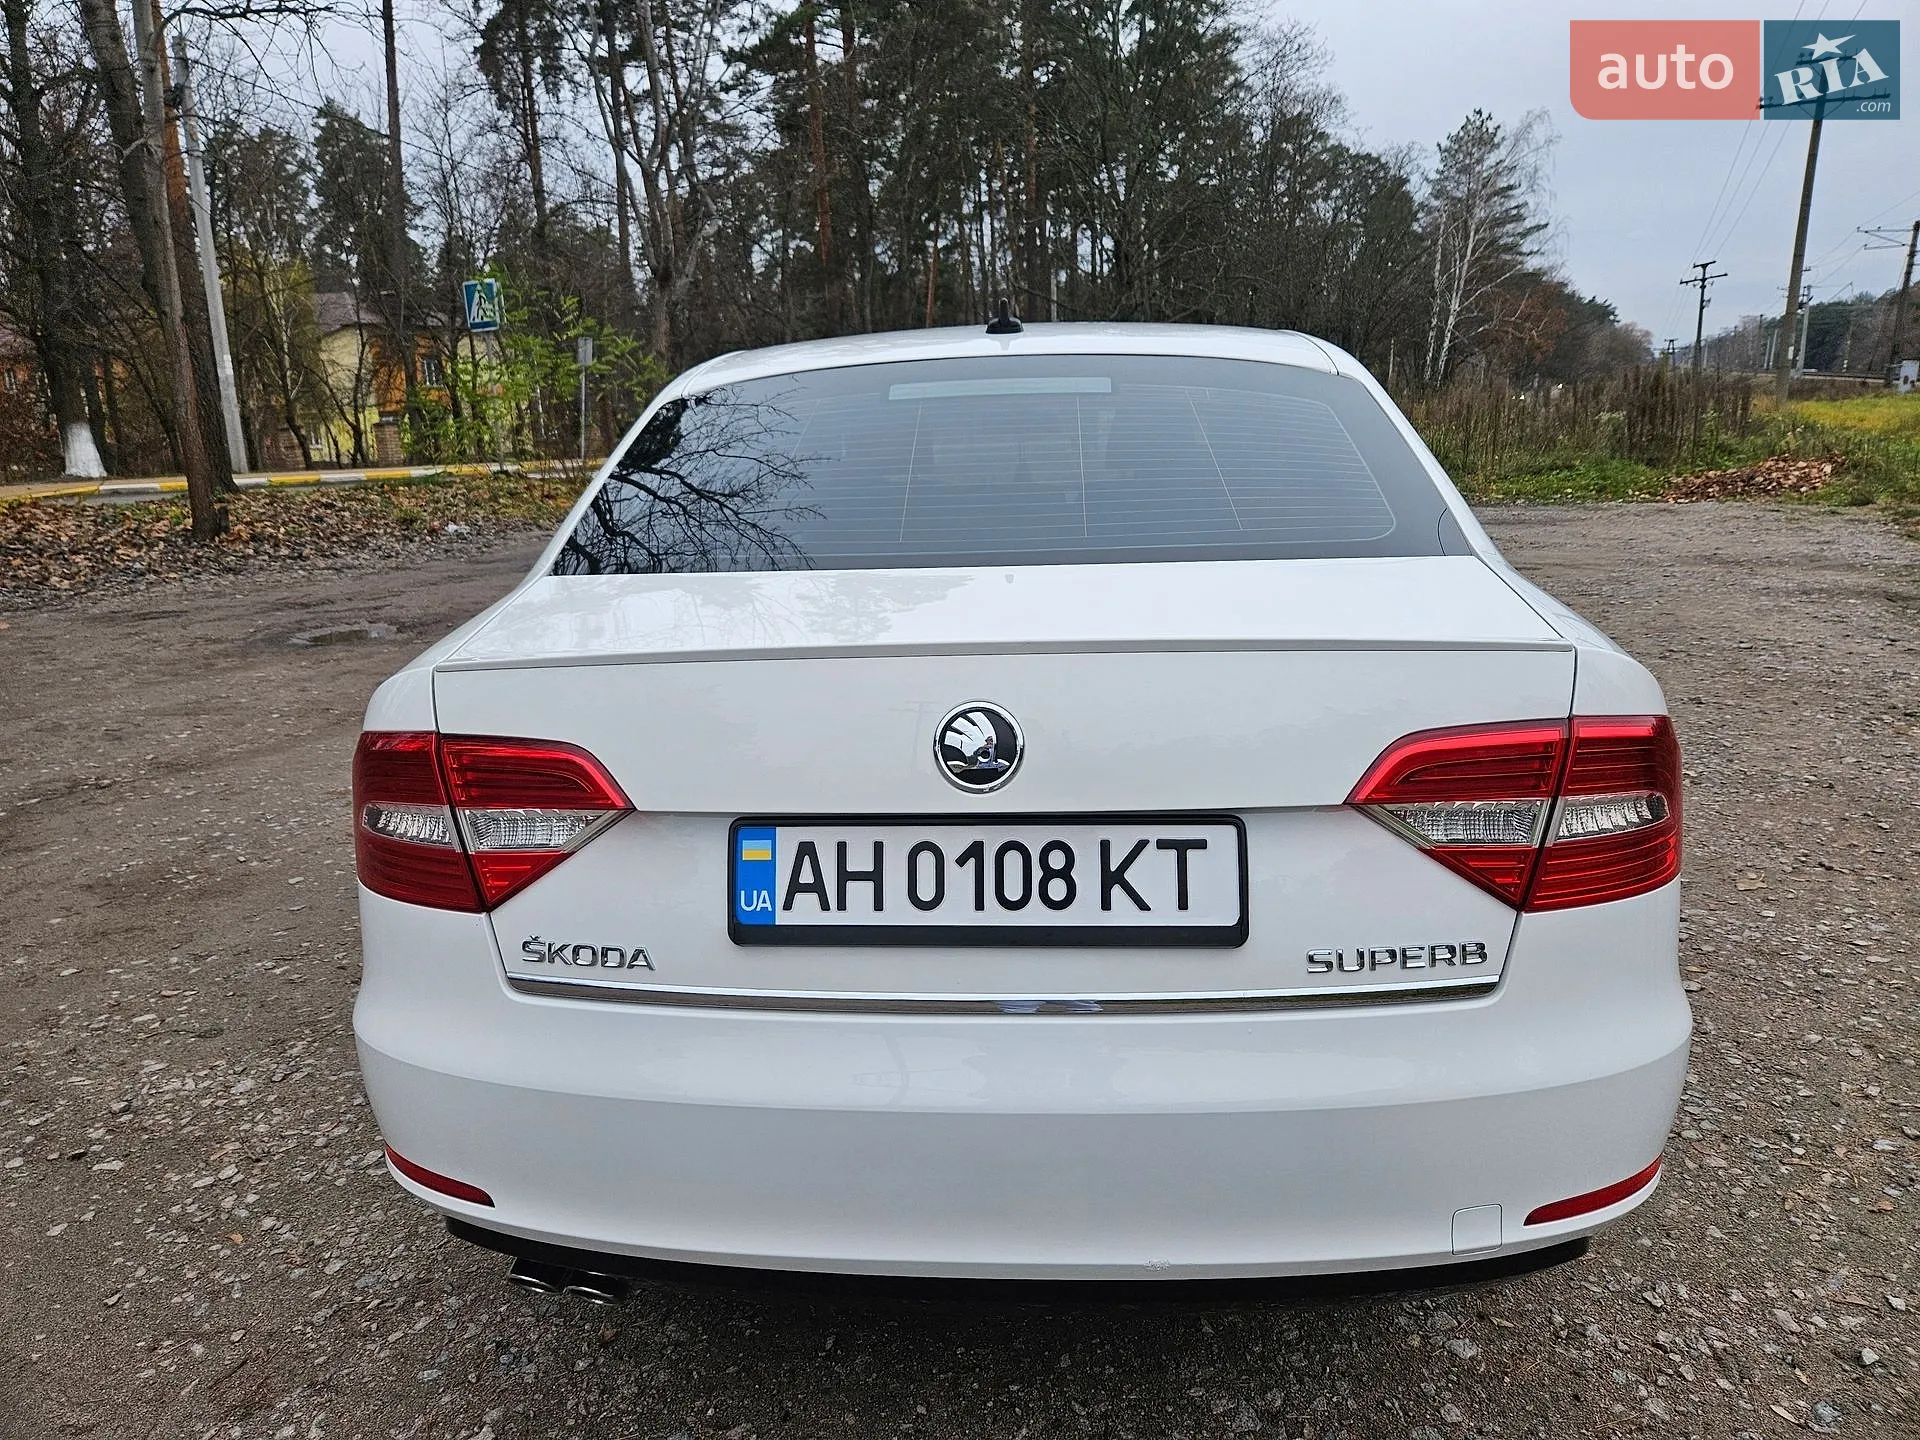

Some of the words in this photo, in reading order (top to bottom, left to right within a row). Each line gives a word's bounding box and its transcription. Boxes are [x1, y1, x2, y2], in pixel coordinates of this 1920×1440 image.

[782, 839, 885, 912] AH
[906, 839, 1077, 912] 0108
[1099, 838, 1208, 912] KT
[740, 890, 772, 912] UA
[522, 935, 656, 971] ŠKODA
[1306, 941, 1488, 974] SUPERB
